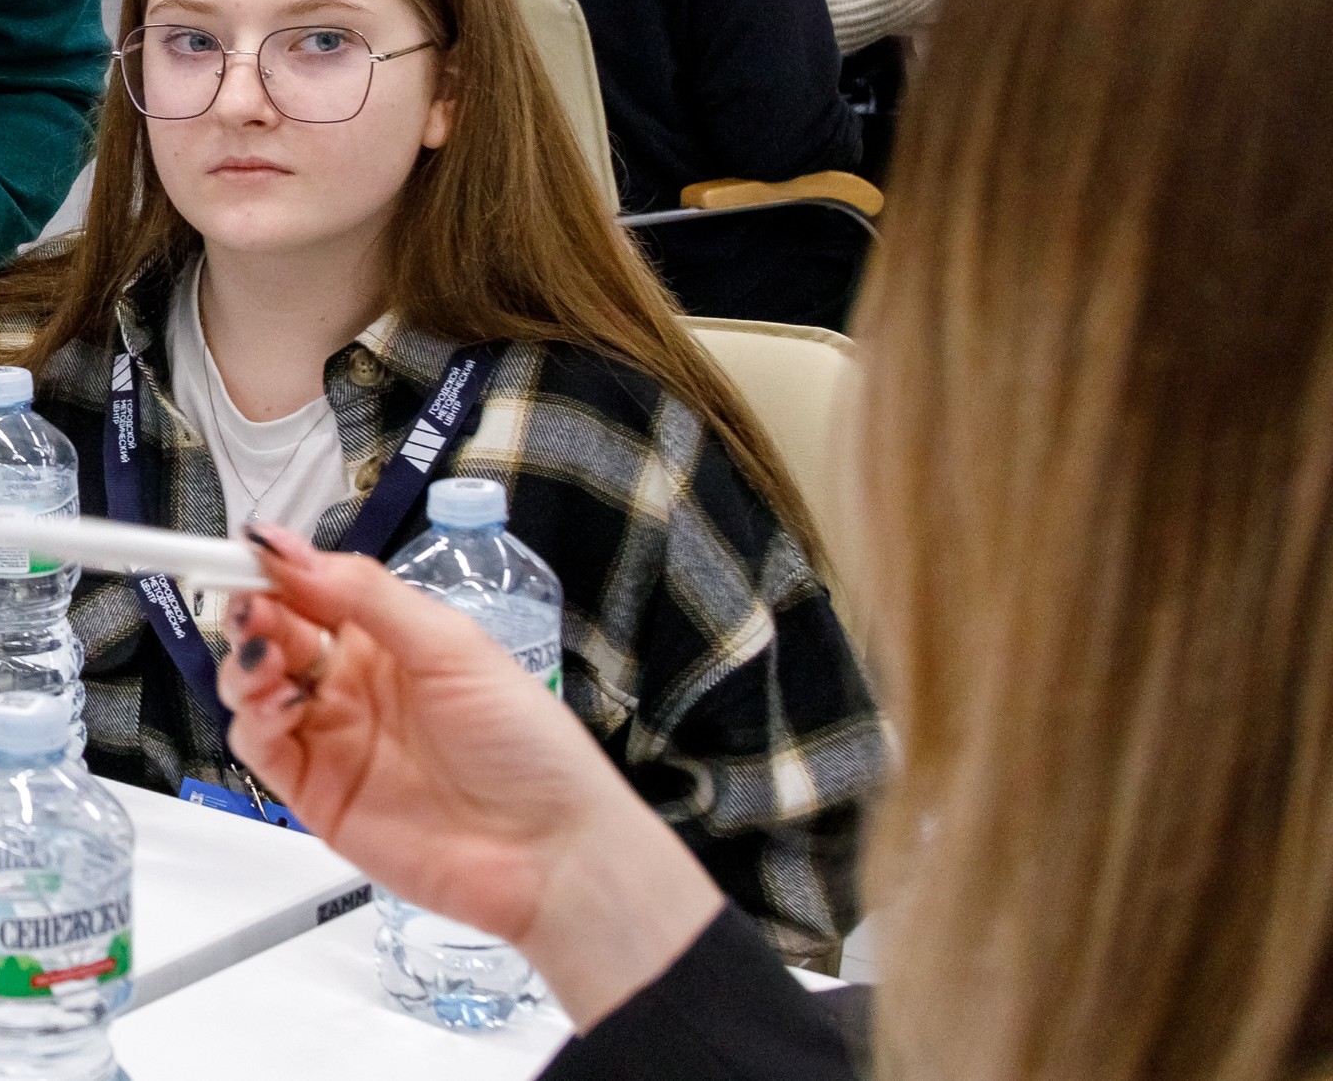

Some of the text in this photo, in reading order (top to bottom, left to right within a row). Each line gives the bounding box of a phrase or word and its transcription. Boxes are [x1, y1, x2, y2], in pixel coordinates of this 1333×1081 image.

[113, 401, 121, 425] ЦЕНТР
[428, 367, 461, 415] ГОРОДСКОЙ
[435, 359, 476, 421] МЕТОДИЧЕСКИЙ
[443, 401, 462, 426] ЦЕНТР
[119, 399, 130, 463] МЕТОДИЧЕСКИЙ
[126, 399, 137, 449] ГОРОДСКОЙ
[140, 579, 157, 603] ЦЕНТР
[149, 576, 186, 639] МЕТОДИЧЕСКИЙ
[156, 573, 187, 623] ГОРОДСКОЙ
